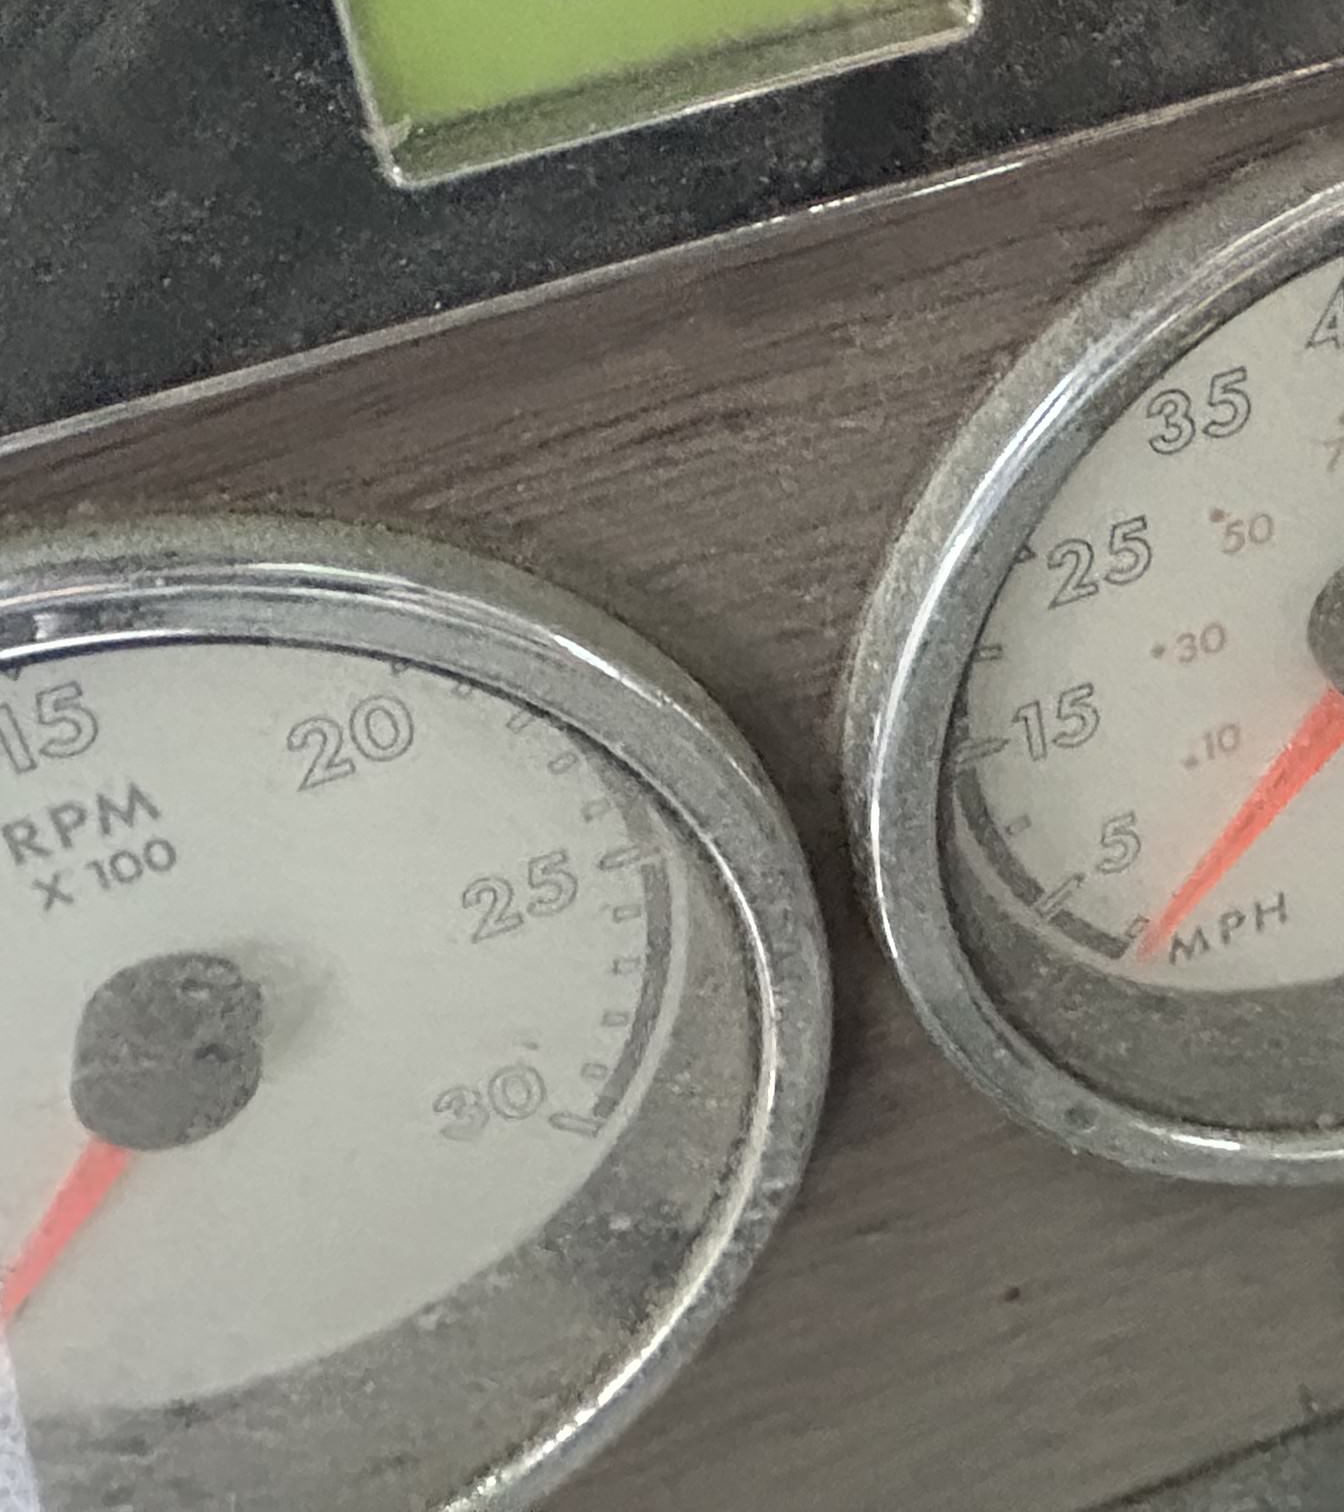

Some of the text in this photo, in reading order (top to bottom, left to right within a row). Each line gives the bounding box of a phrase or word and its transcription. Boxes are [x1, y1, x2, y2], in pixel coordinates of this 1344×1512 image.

[1146, 365, 1251, 455] 35
[1047, 515, 1152, 610] 25
[1221, 512, 1275, 555] 50
[1175, 622, 1227, 664] 30
[286, 694, 414, 792] 20
[1012, 682, 1101, 761] 15
[1204, 723, 1242, 760] 10
[1, 781, 162, 865] RPM
[1095, 810, 1142, 875] 5
[85, 837, 177, 890] 100
[462, 848, 578, 944] 25
[1167, 892, 1288, 965] MPH
[432, 1064, 547, 1141] 30
